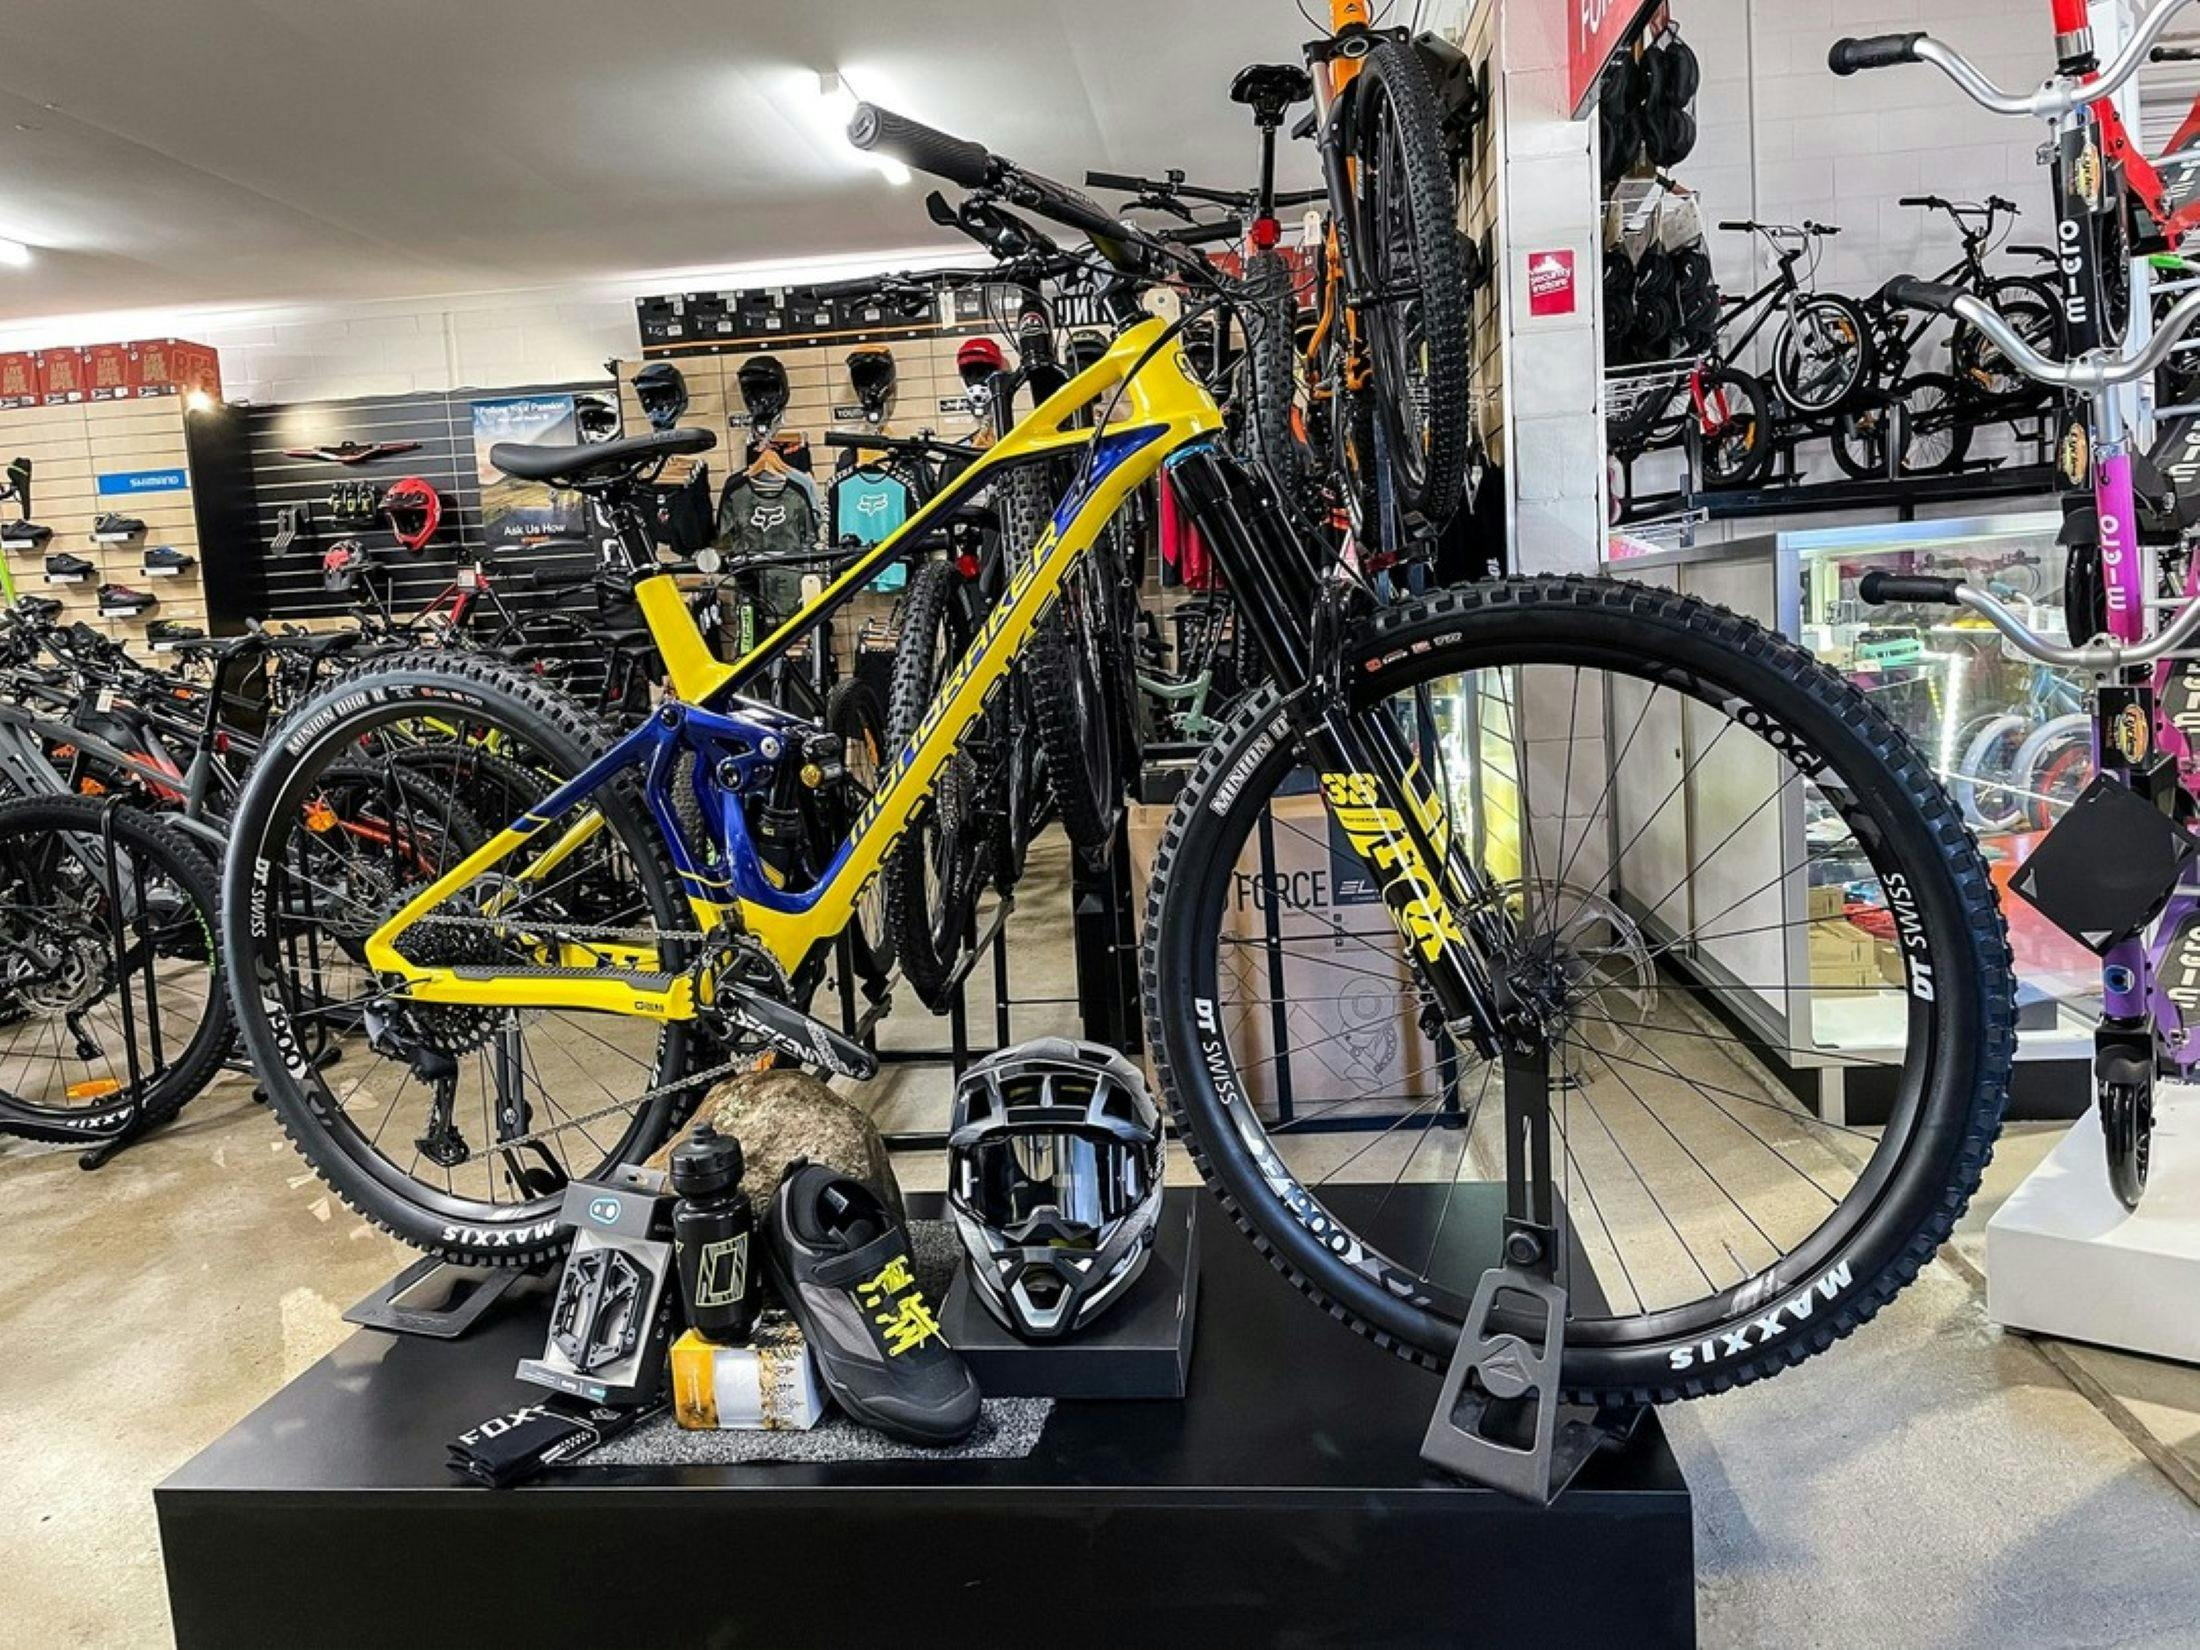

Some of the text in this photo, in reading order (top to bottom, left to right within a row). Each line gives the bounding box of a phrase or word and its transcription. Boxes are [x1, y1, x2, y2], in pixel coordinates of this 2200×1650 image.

[2059, 220, 2087, 324] micro
[503, 522, 567, 536] Ask Us How
[2100, 514, 2128, 610] micro
[251, 886, 270, 938] SWISS
[1882, 872, 1935, 1001] SWISS DT
[1195, 997, 1239, 1105] DT SWISS
[442, 1219, 557, 1247] MAXXIS
[1668, 1260, 1854, 1371] MAXXIS
[458, 1405, 546, 1446] FOX
